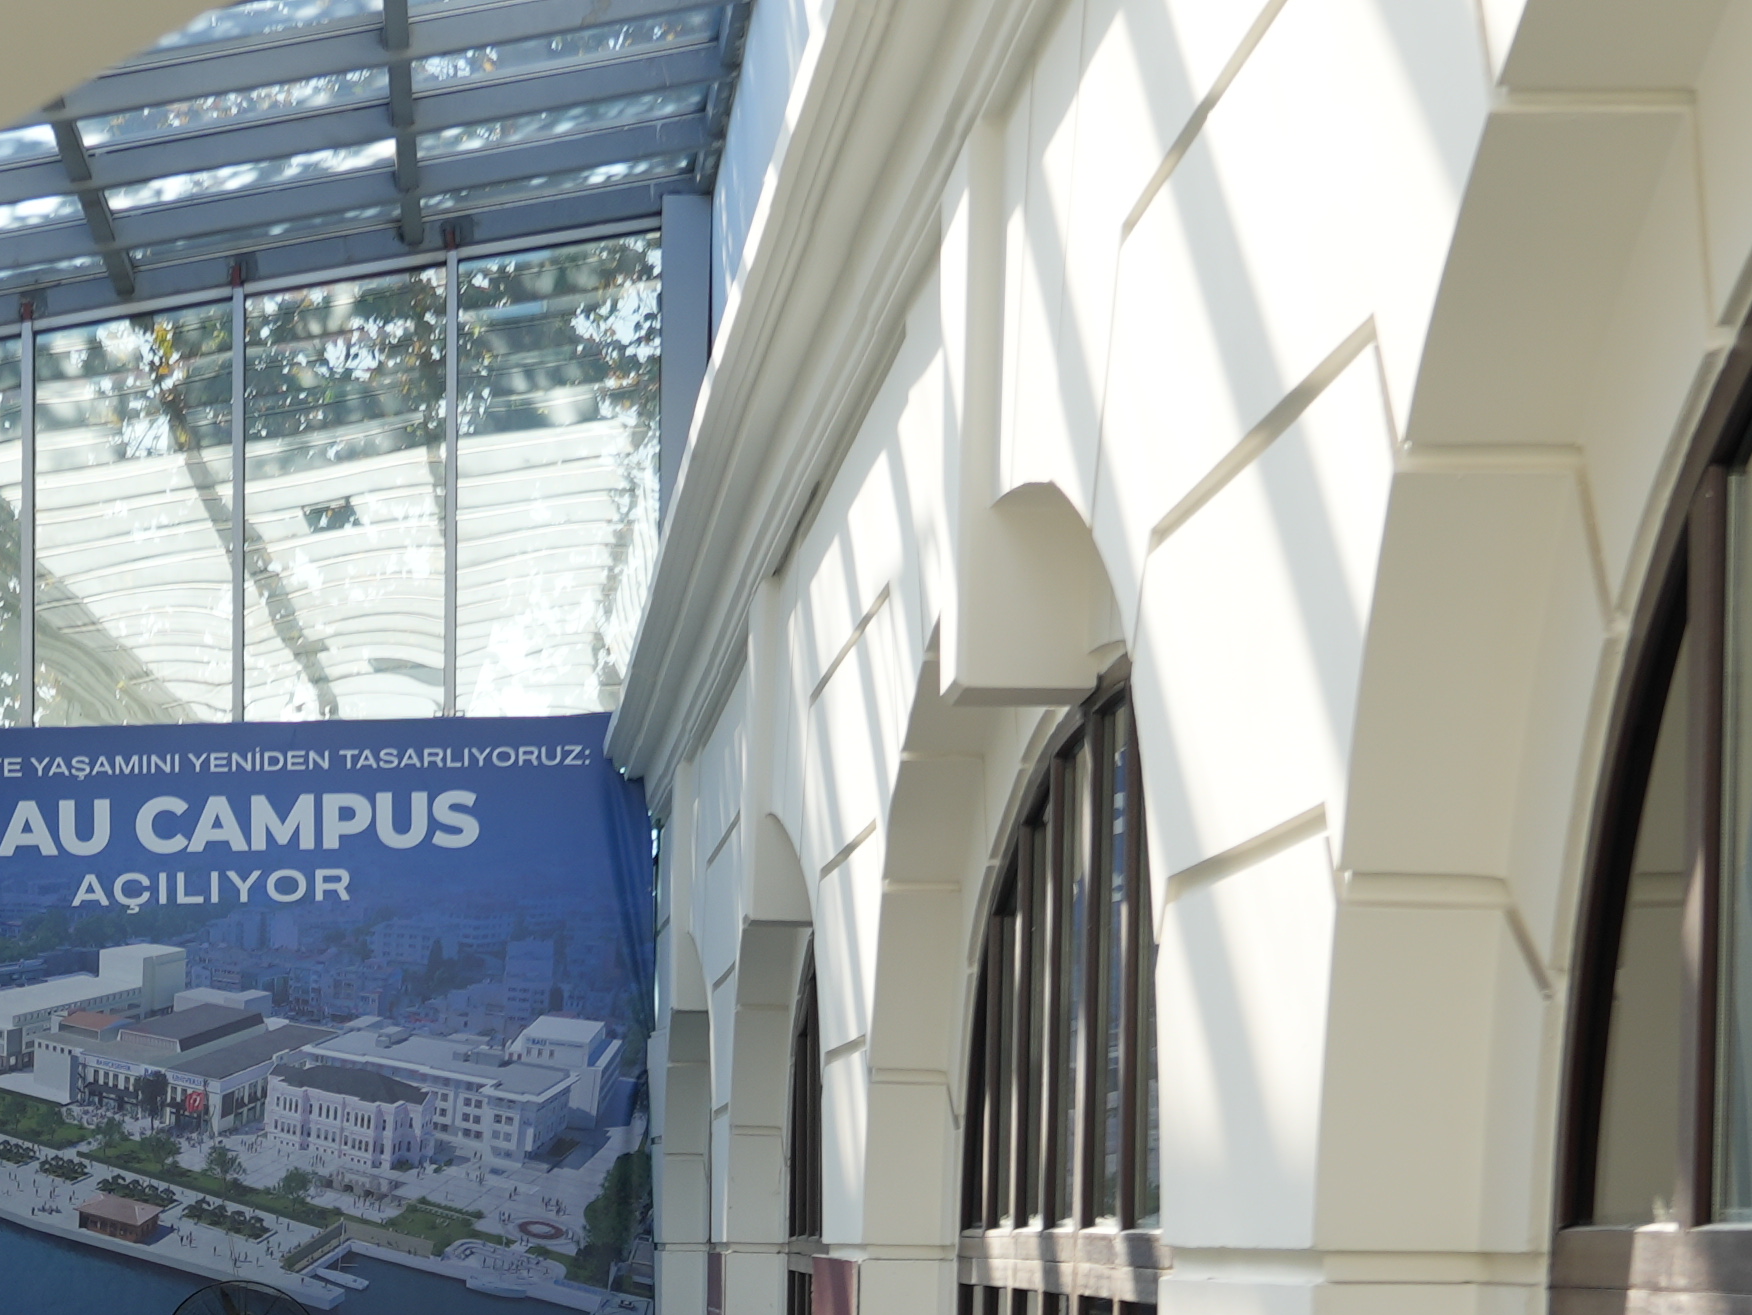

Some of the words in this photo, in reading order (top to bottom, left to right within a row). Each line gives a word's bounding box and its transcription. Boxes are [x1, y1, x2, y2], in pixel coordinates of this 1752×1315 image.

[30, 753, 181, 782] YAŞAMINI
[187, 746, 331, 774] YENİDEN
[340, 743, 592, 770] TASARLIYORUZ:
[135, 789, 481, 854] CAMPUS
[71, 867, 351, 914] AÇILIYOR
